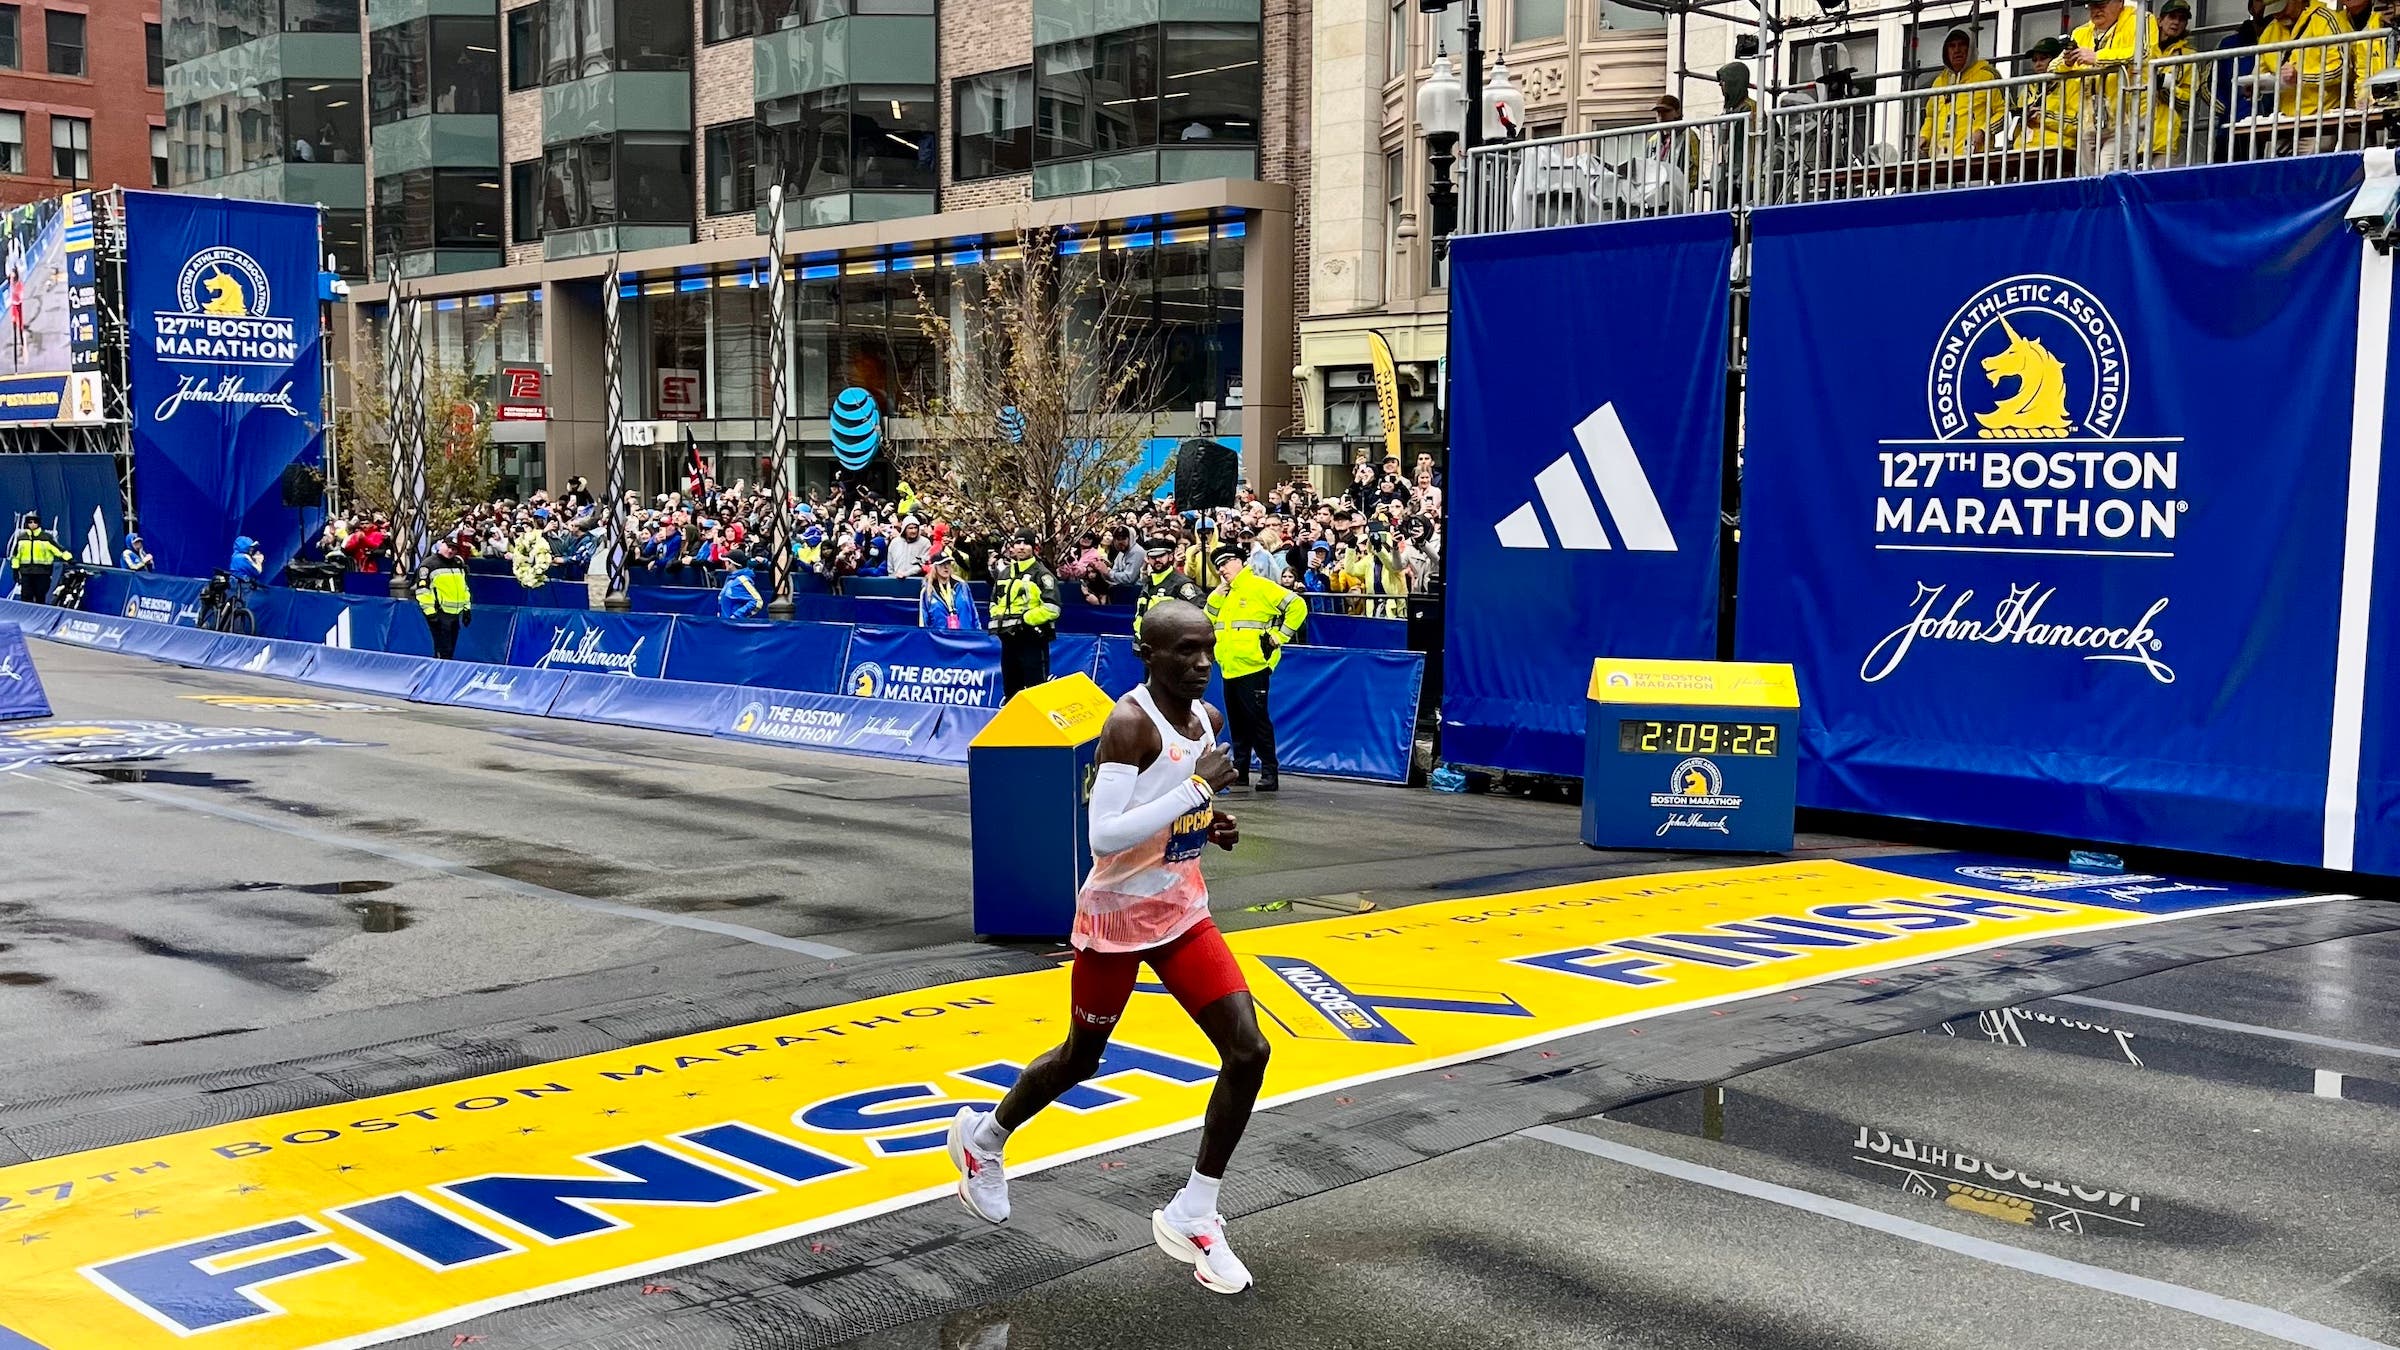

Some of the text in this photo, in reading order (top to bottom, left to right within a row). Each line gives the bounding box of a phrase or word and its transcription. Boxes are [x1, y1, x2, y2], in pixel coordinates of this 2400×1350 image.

[181, 250, 267, 314] BOSTON ATHLETIC ASSOCIATION
[155, 316, 293, 340] 127TH BOSTON
[1938, 284, 2119, 431] BOSTON ATHLETIC ASSOCIATION
[155, 374, 214, 421] John
[1384, 370, 1397, 433] Sports
[1878, 451, 2178, 490] 127TH BOSTON
[534, 625, 646, 678] John Hancock
[1860, 580, 1983, 683] John
[889, 664, 918, 683] THE
[920, 666, 985, 687] BOSTON
[1635, 680, 1714, 690] MARATHON
[1662, 673, 1713, 682] BOSTON
[767, 705, 793, 722] THE
[791, 708, 846, 727] BOSTON
[1641, 721, 1777, 755] 2:09:22
[1650, 795, 1688, 805] BOSTON
[1656, 812, 1688, 837] John
[1327, 871, 1829, 942] 127TH BOSTON MARATHON
[1502, 890, 2084, 989] FINISH
[1276, 965, 1356, 1012] BOSTON
[1074, 1003, 1119, 1025] INEOS
[1339, 1008, 1374, 1030] ONE
[0, 995, 996, 1213] 27TH BOSTON MARATHON
[76, 1039, 1223, 1338] FINISH
